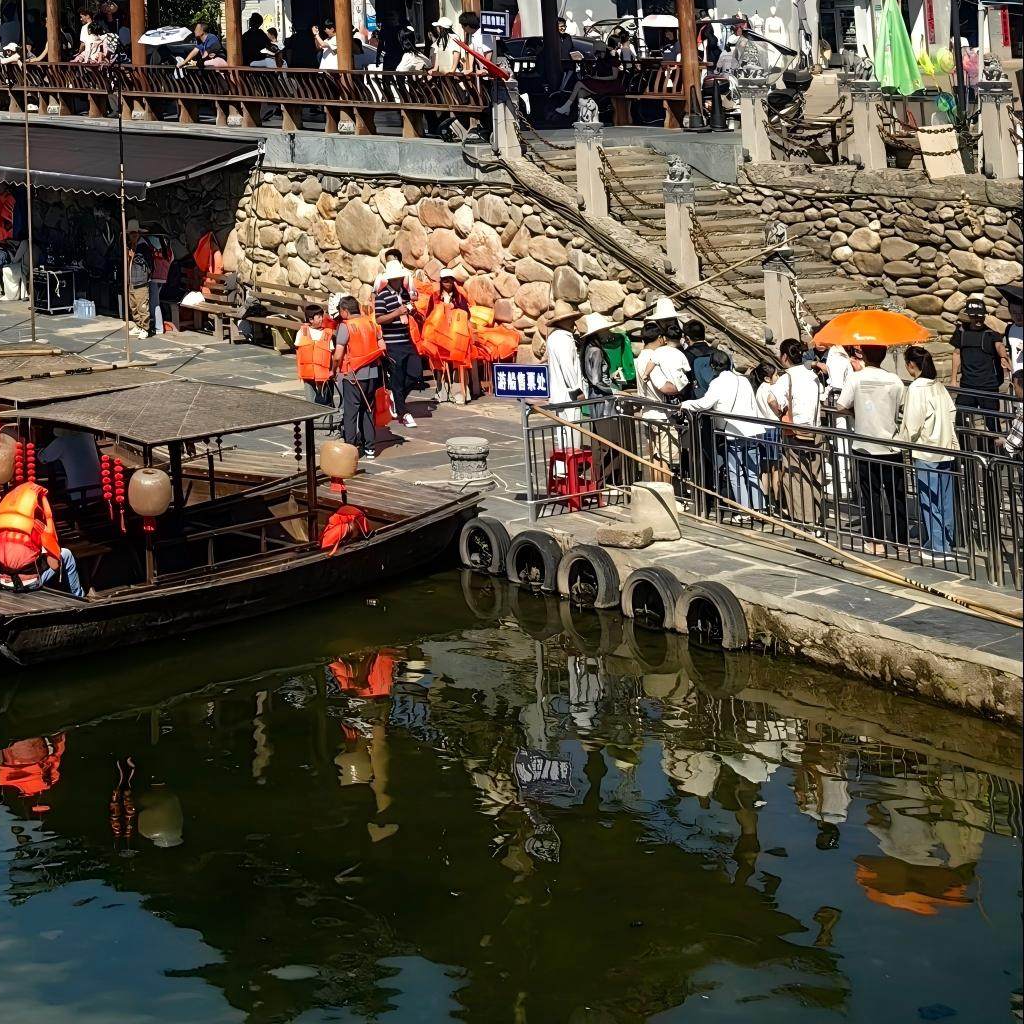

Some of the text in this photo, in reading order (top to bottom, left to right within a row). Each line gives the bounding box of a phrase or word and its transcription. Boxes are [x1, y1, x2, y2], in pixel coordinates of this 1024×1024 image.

[497, 371, 547, 391] 游船售票处
